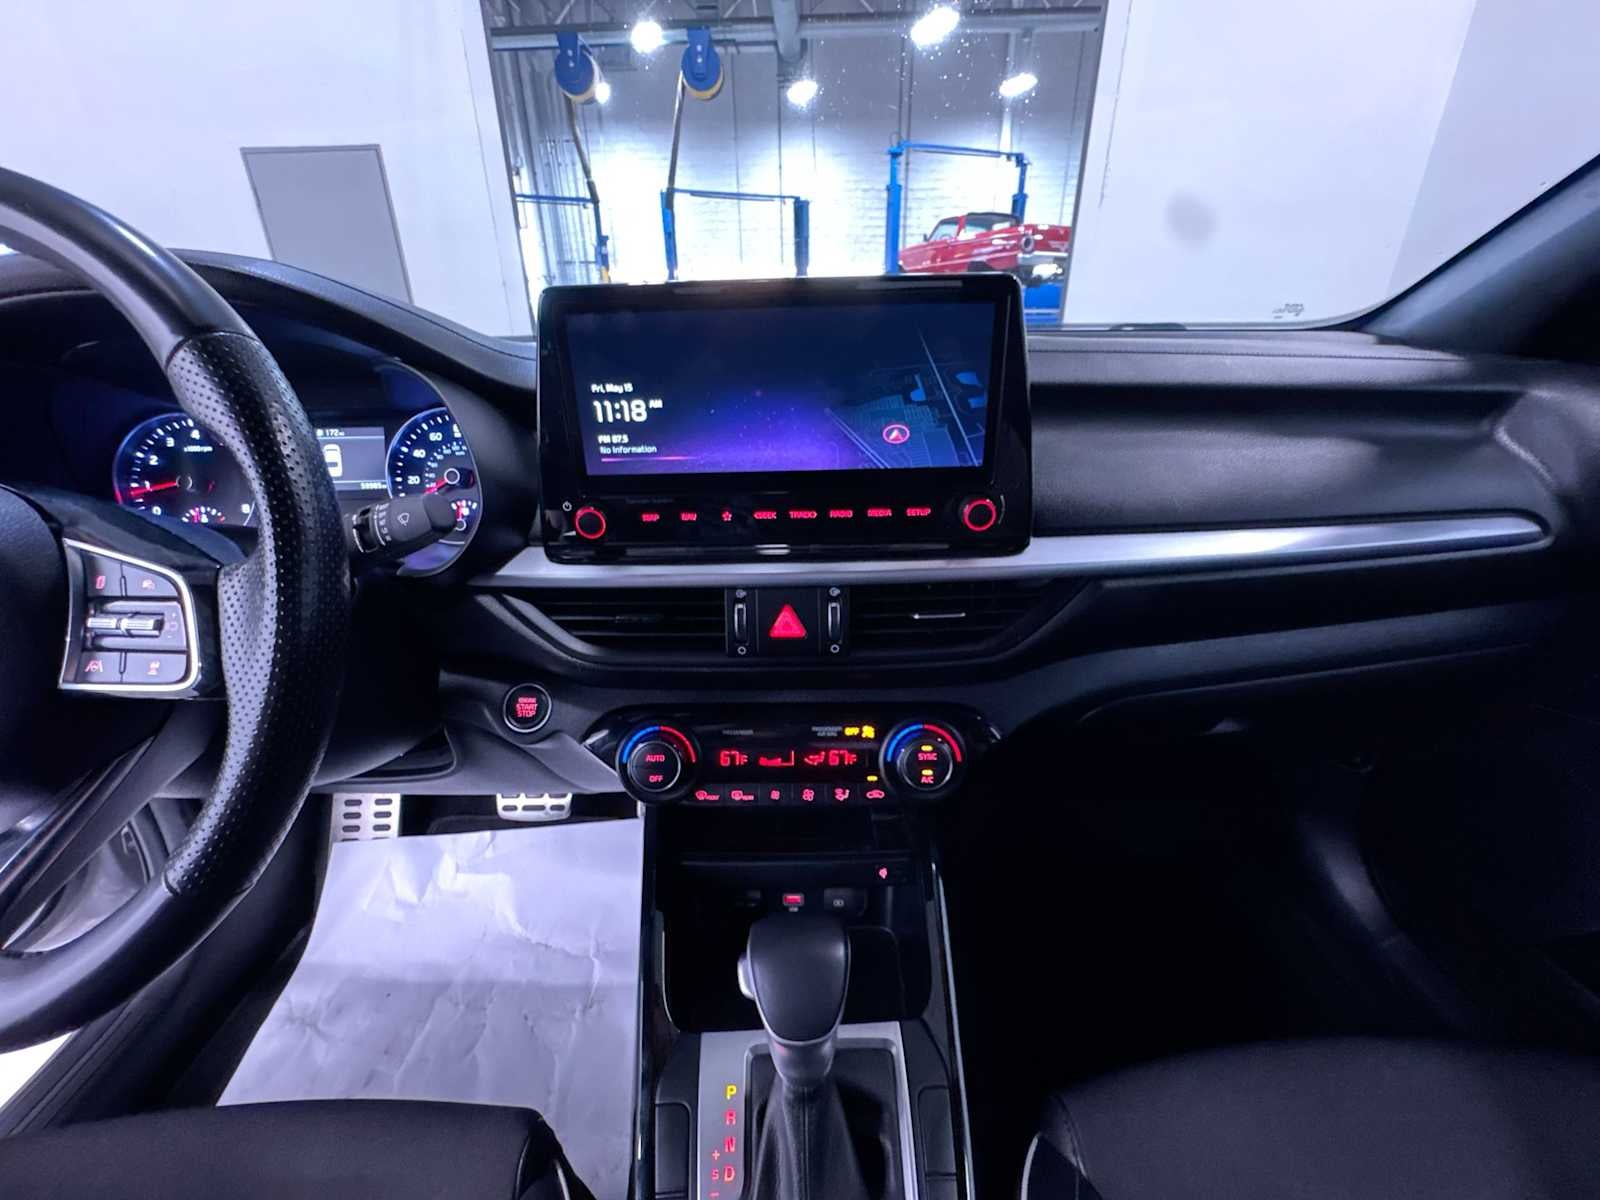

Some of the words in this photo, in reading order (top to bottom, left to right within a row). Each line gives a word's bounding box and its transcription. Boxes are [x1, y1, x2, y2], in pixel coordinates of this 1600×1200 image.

[593, 399, 648, 423] 11:18
[166, 437, 175, 448] 3
[600, 446, 611, 454] No
[612, 445, 658, 454] Information
[149, 455, 159, 466] 2
[407, 475, 420, 485] 20
[152, 506, 162, 516] 0
[645, 754, 666, 763] AUTO
[918, 752, 938, 761] SYNC
[649, 775, 663, 783] OFF
[920, 776, 934, 784] A/C
[726, 1084, 737, 1100] P
[725, 1110, 736, 1125] R
[724, 1136, 736, 1153] N
[711, 1167, 720, 1180] S
[724, 1166, 735, 1182] D
